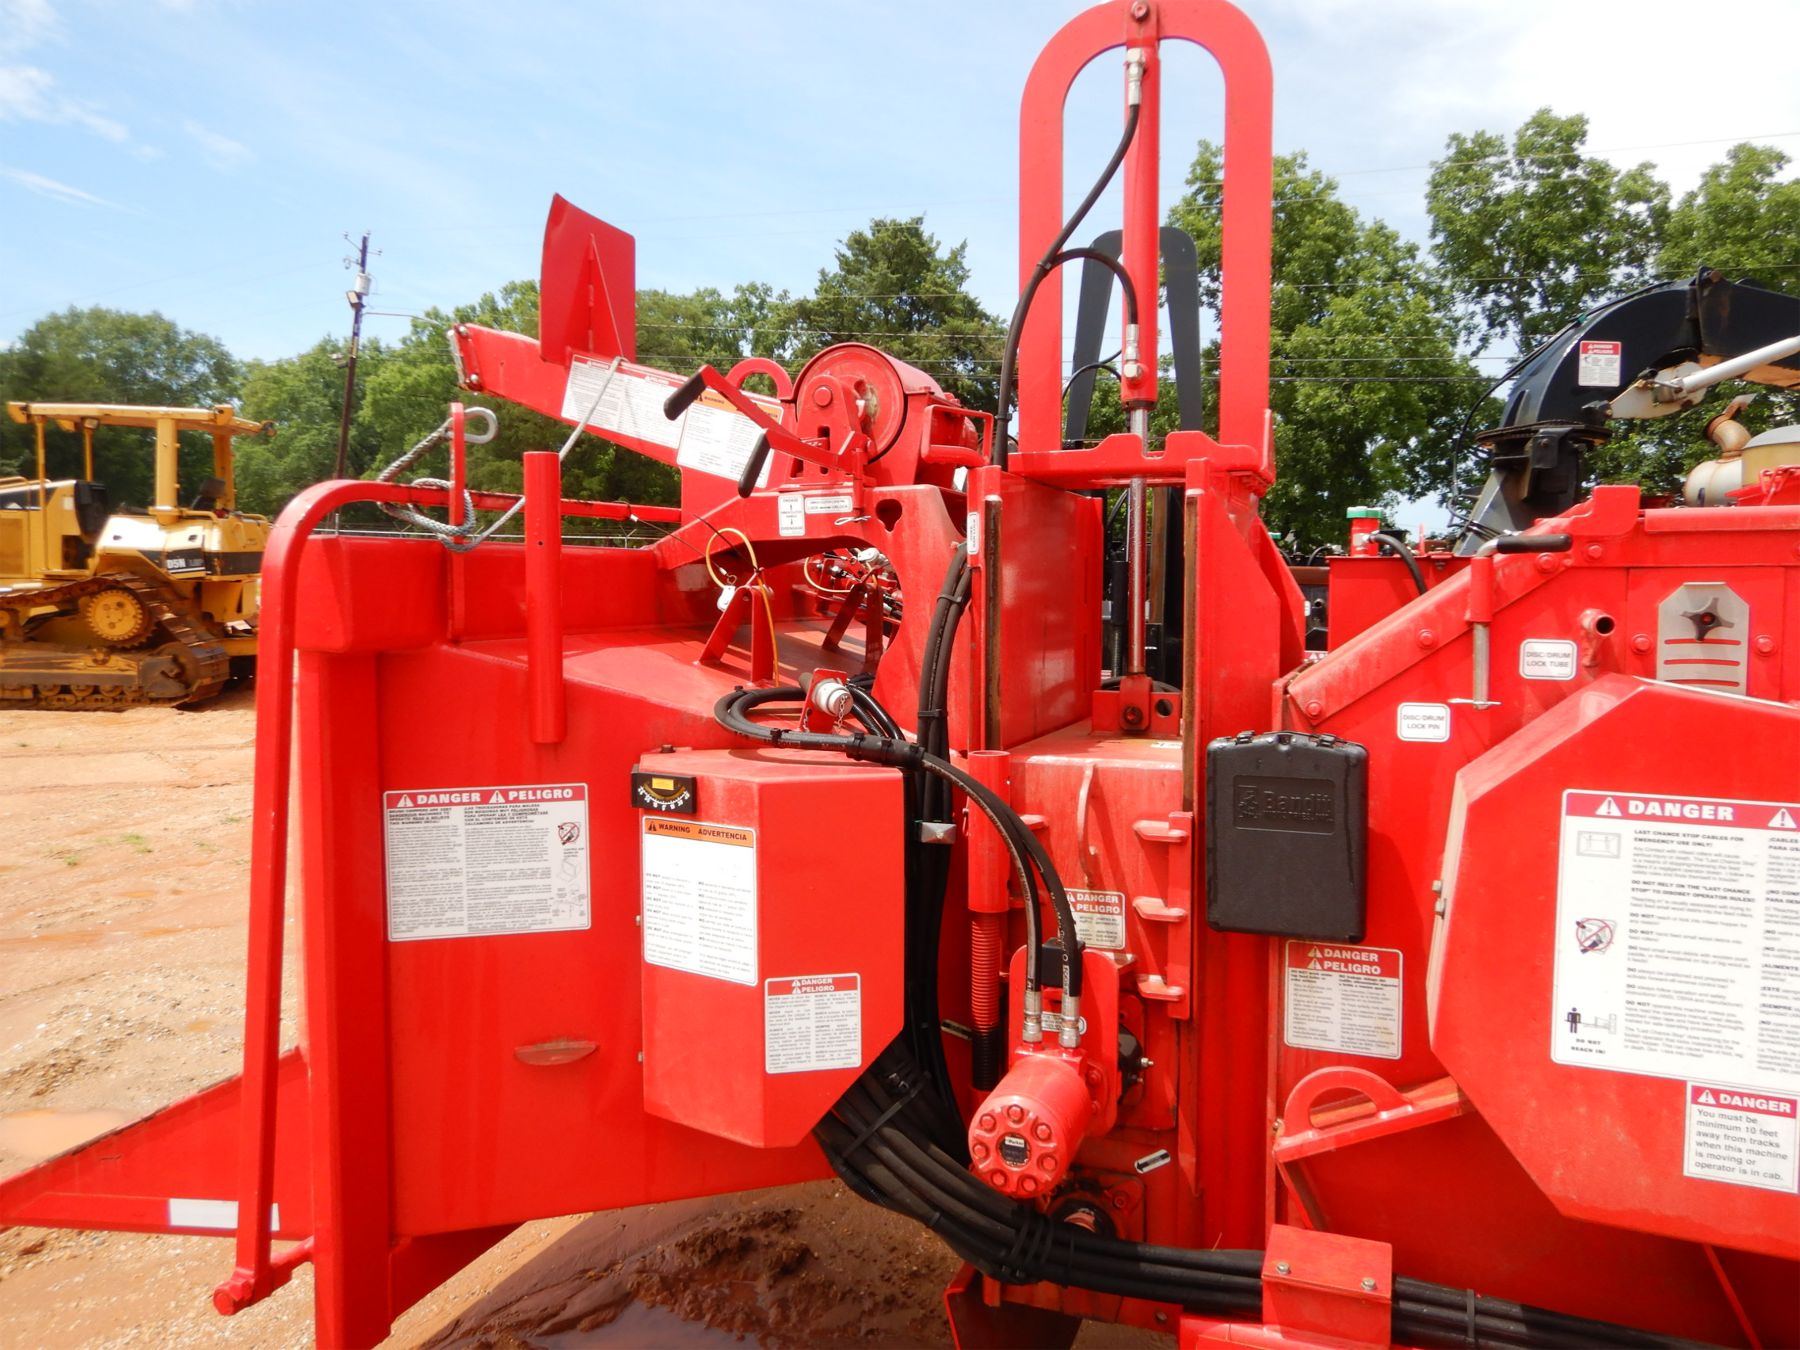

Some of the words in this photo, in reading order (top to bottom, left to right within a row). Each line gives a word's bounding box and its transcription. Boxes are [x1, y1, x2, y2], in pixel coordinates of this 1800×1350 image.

[416, 792, 481, 804] DANGER
[508, 788, 573, 800] PELIGRO
[1628, 800, 1734, 821] DANGER
[658, 823, 690, 833] WARNING
[698, 828, 747, 840] ADVERTENCIA
[1077, 893, 1118, 903] DANGER
[1077, 904, 1120, 914] PELIGRO
[1324, 948, 1379, 962] DANGER
[1324, 960, 1381, 974] PELIGRO
[1720, 1093, 1792, 1114] DANGER
[1697, 1108, 1715, 1118] You
[1718, 1113, 1742, 1122] must
[1746, 1116, 1758, 1124] be
[1696, 1120, 1741, 1132] minimum
[1760, 1128, 1778, 1137] feet
[1696, 1130, 1719, 1140] away
[1724, 1133, 1746, 1143] from
[1750, 1138, 1780, 1148] tracks
[1696, 1140, 1721, 1149] when
[1724, 1144, 1742, 1153] this
[1746, 1147, 1788, 1160] machine
[1706, 1152, 1743, 1165] moving
[1695, 1161, 1735, 1172] operator
[1763, 1171, 1783, 1180] cab.
